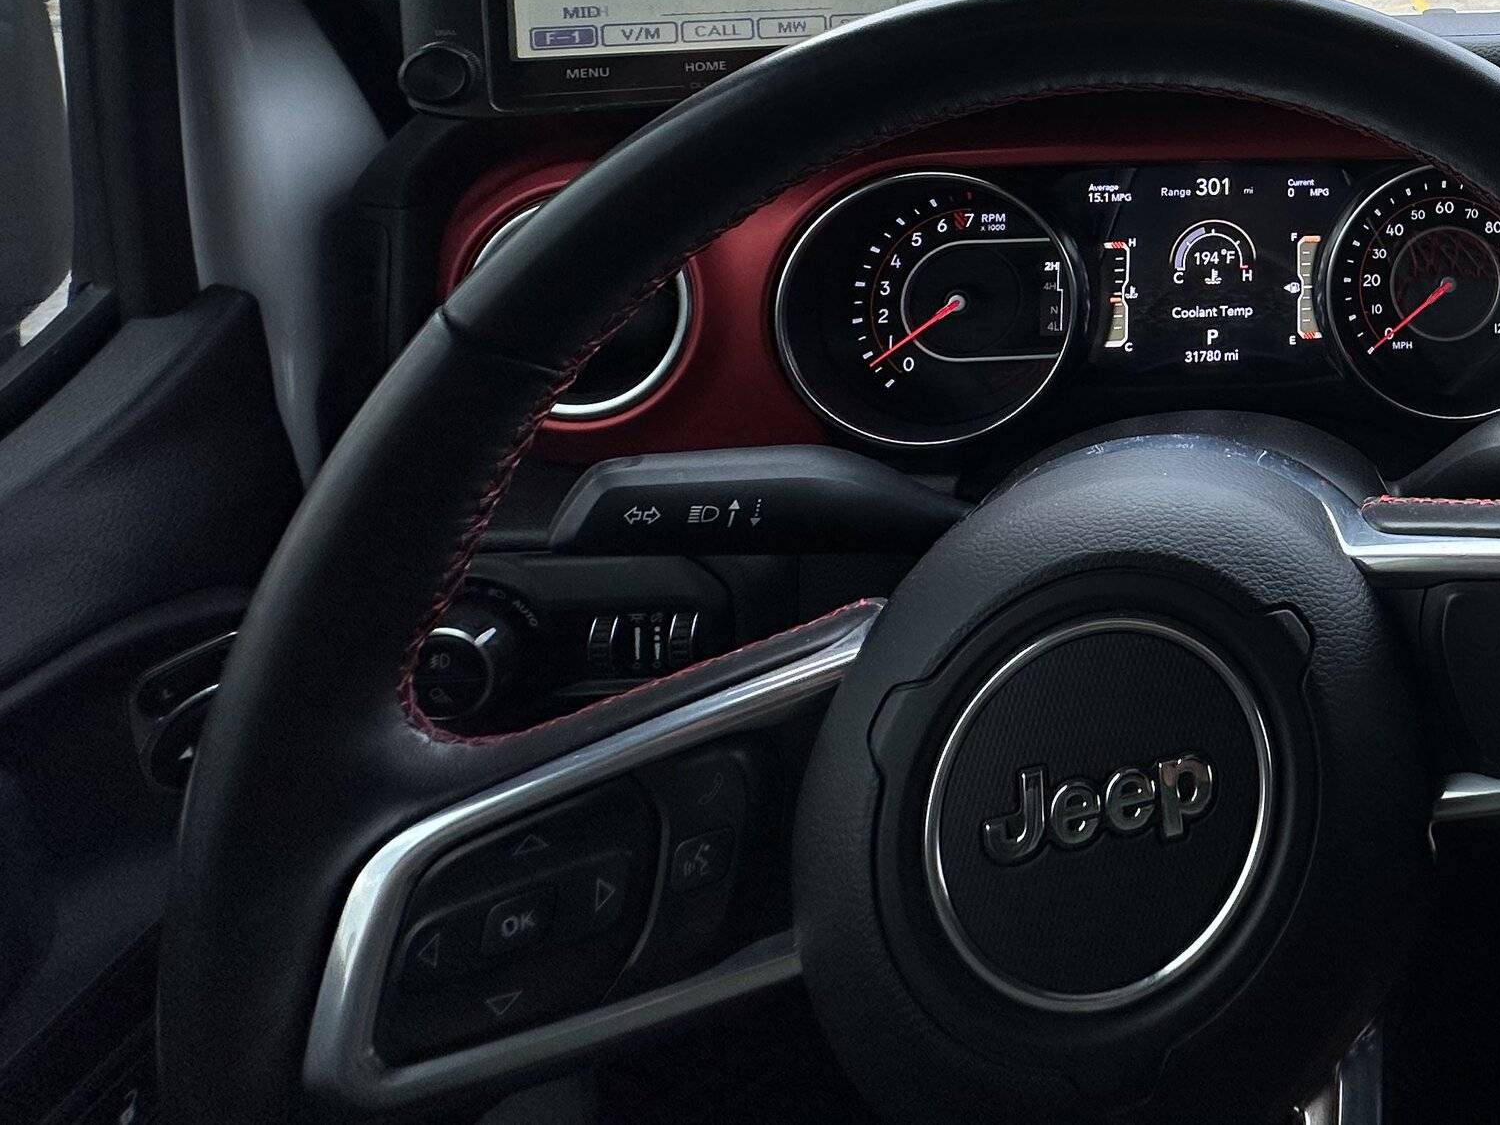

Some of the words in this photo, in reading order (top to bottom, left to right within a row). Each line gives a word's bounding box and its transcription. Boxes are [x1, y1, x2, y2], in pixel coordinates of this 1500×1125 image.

[621, 26, 661, 42] V/M
[694, 24, 741, 38] CALL
[778, 21, 807, 34] MW
[545, 31, 581, 43] F-1
[566, 67, 610, 79] MENU
[685, 61, 727, 73] HOME
[1088, 183, 1119, 193] Average
[1161, 187, 1192, 198] Range
[1195, 177, 1231, 196] 301
[1243, 186, 1254, 195] mi
[1287, 178, 1315, 187] Current
[1088, 193, 1109, 203] 15.1
[1111, 192, 1132, 203] MPG
[1287, 188, 1295, 198] 0
[1310, 188, 1330, 197] MPG
[1435, 201, 1455, 214] 60
[1465, 208, 1479, 220] 70
[965, 213, 975, 228] 7
[981, 213, 1006, 223] RPM
[1411, 209, 1426, 221] 50
[936, 219, 948, 233] 6
[1385, 223, 1404, 236] 40
[911, 232, 922, 247] 5
[1128, 238, 1137, 248] H
[1291, 232, 1298, 242] F
[1372, 248, 1387, 260] 30
[890, 254, 902, 269] 4
[1173, 271, 1184, 284] C
[1242, 270, 1253, 282] H
[1363, 274, 1381, 287] 20
[879, 281, 891, 296] 3
[1050, 306, 1059, 314] N
[1172, 306, 1218, 319] Coolant
[1220, 305, 1254, 319] Temp
[1371, 304, 1383, 315] 10
[878, 309, 889, 324] 2
[1207, 329, 1219, 345] P
[1288, 335, 1297, 345] E
[1384, 327, 1394, 340] 0
[1124, 342, 1133, 352] C
[1392, 341, 1413, 350] MPH
[1184, 350, 1222, 363] 31780
[1223, 349, 1239, 362] mi
[902, 356, 915, 372] 0
[983, 755, 1213, 860] Jeep
[501, 910, 537, 938] OK
